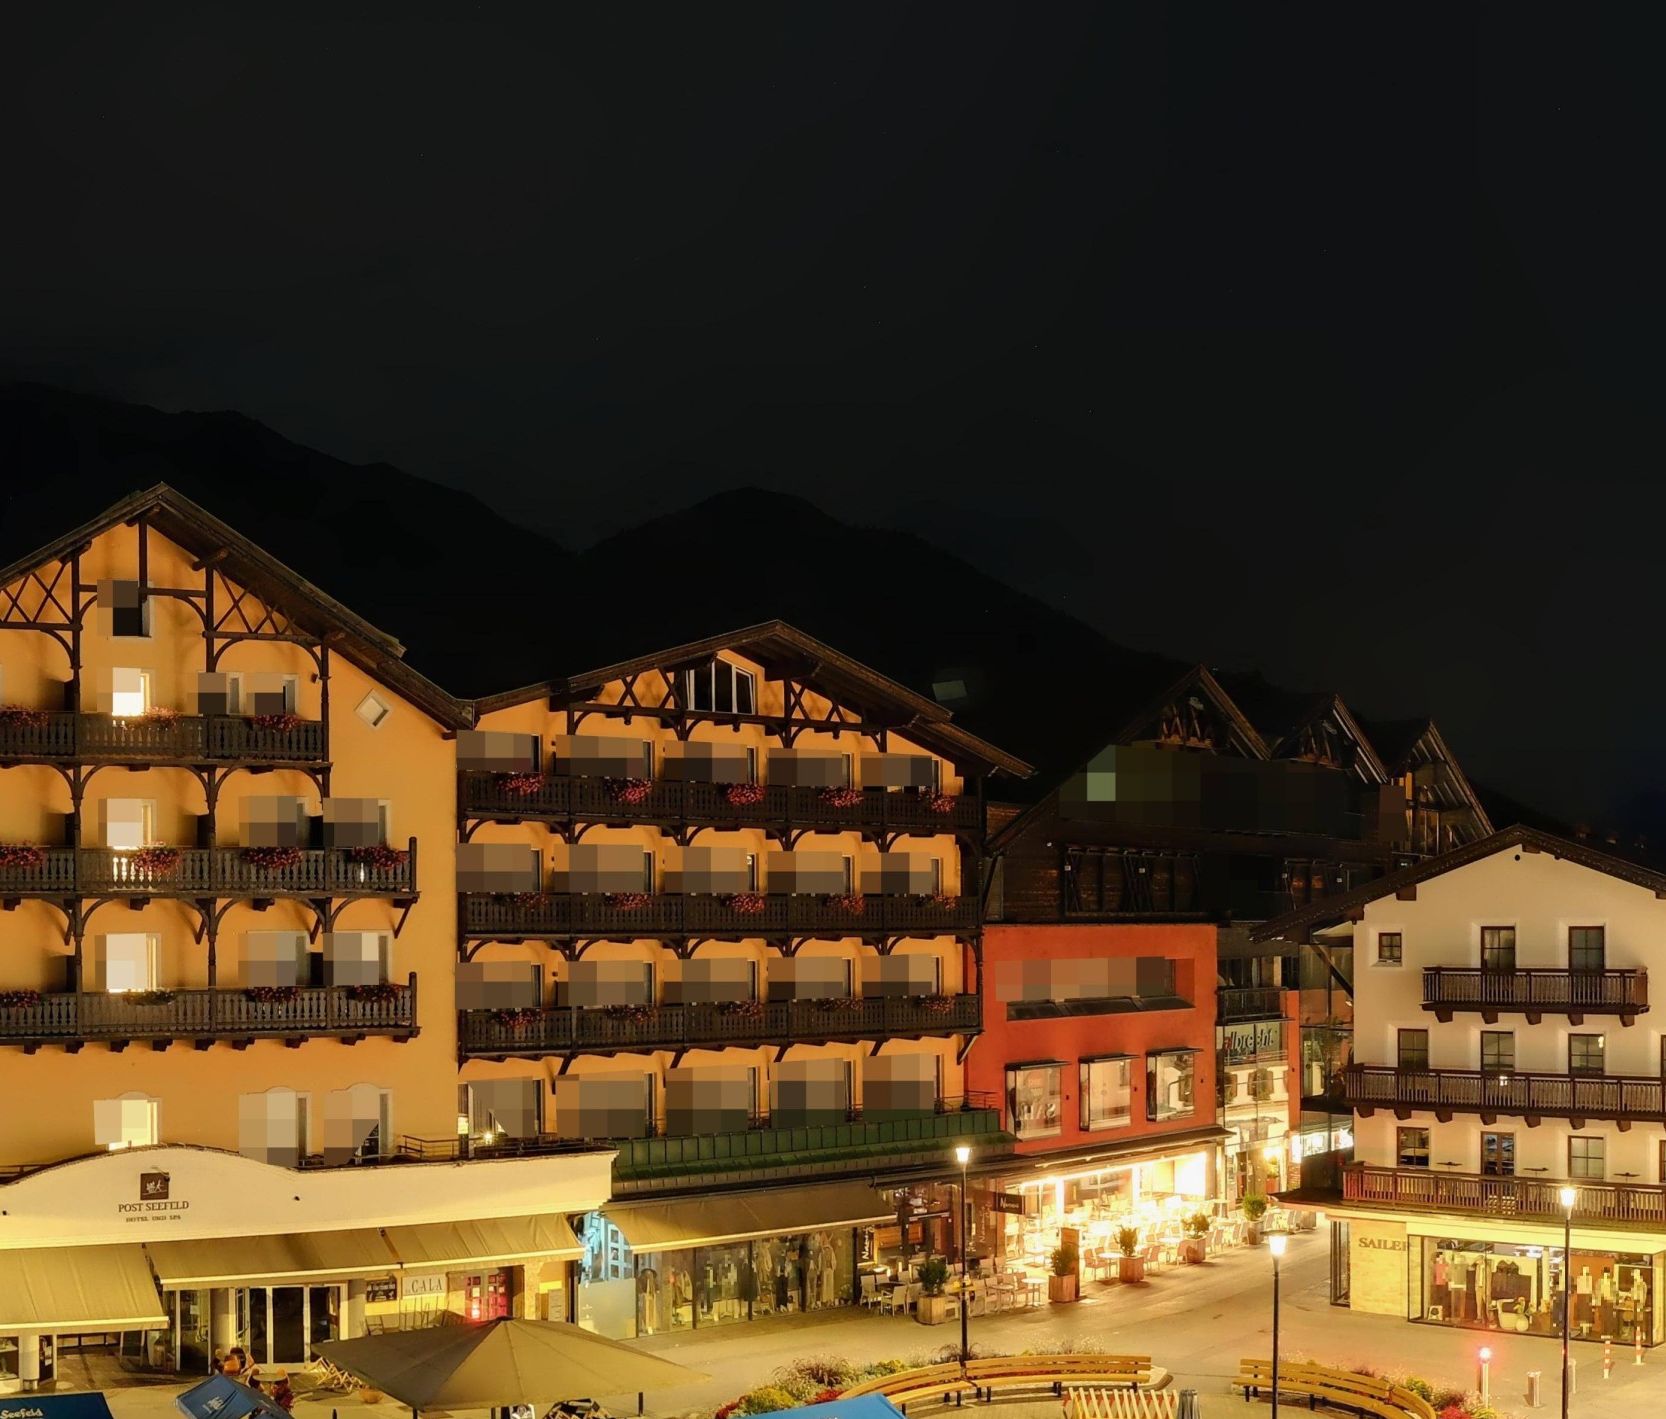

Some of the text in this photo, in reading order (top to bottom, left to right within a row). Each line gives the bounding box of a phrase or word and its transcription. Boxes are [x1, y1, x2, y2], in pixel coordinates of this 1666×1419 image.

[118, 1201, 189, 1213] POST SEEFELD
[411, 1278, 442, 1293] CALA
